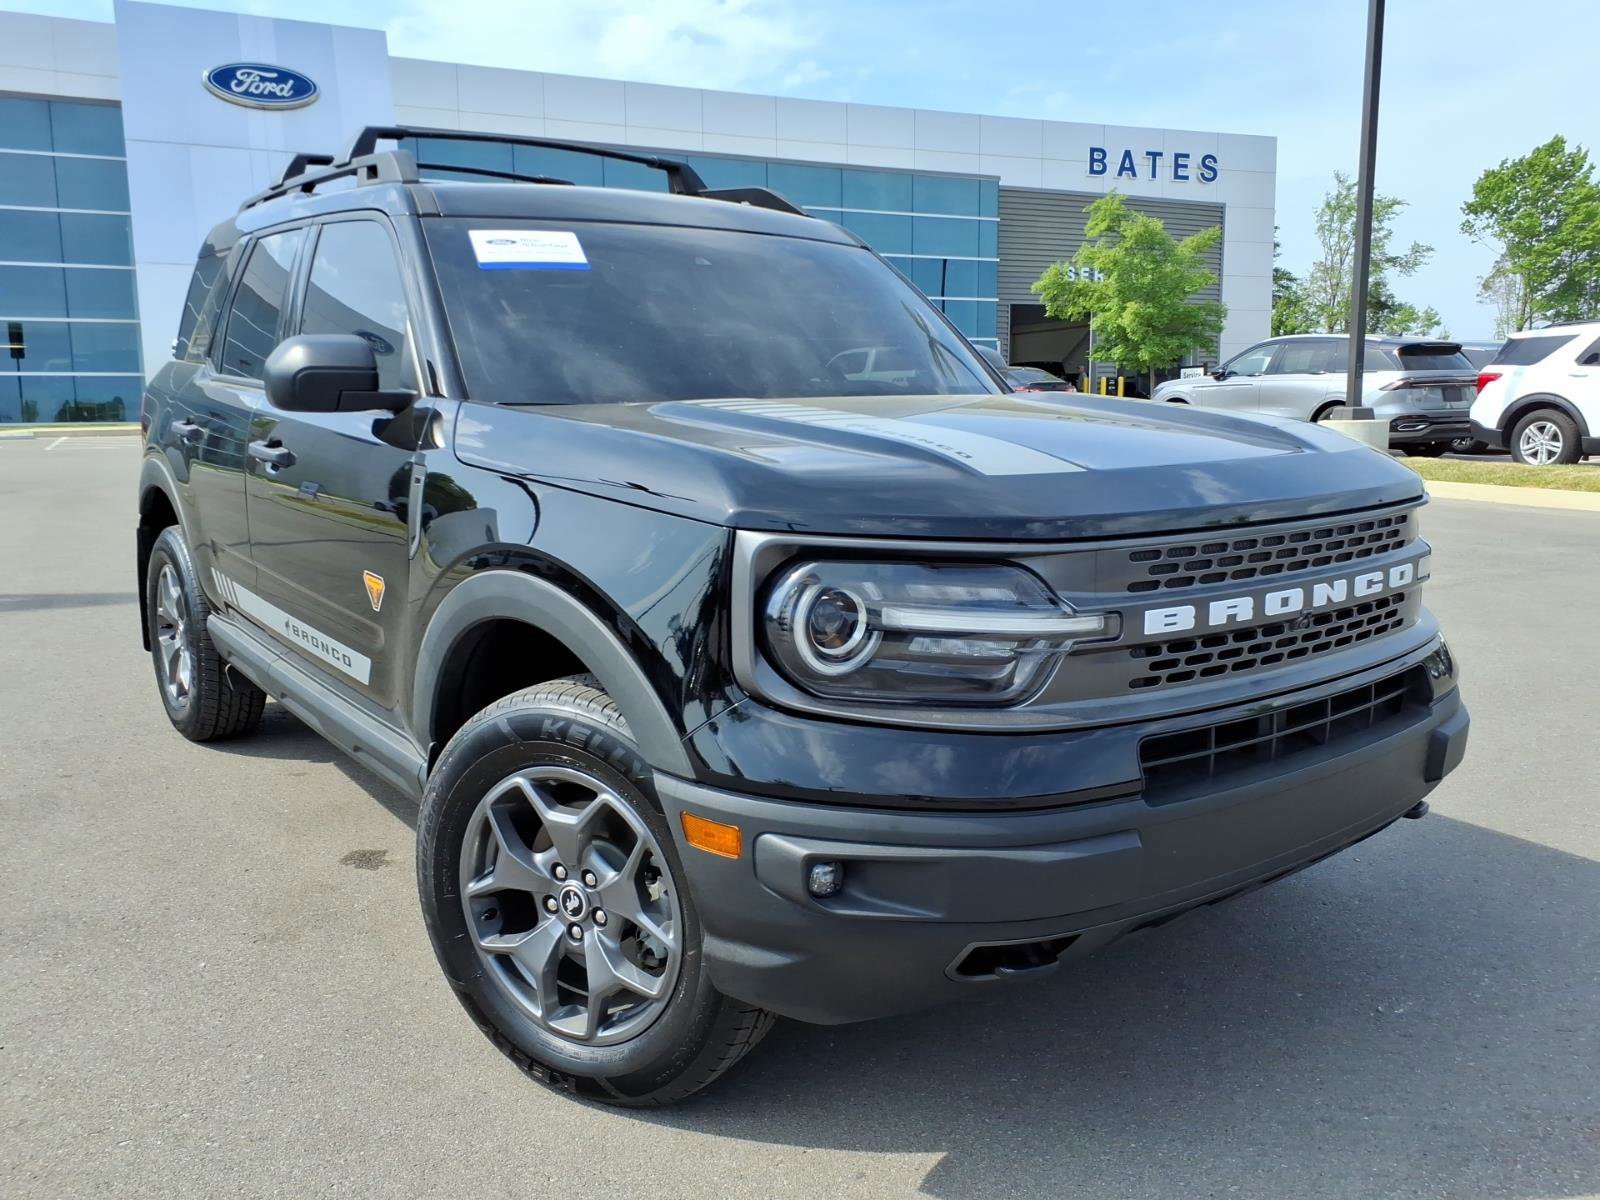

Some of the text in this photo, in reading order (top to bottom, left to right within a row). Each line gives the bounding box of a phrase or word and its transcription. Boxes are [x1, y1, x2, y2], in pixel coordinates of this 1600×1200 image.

[231, 69, 294, 97] Ford
[1088, 147, 1218, 183] BATES
[1144, 563, 1413, 635] BRONCO
[292, 624, 352, 668] BRONCO
[540, 717, 653, 782] KELLY
